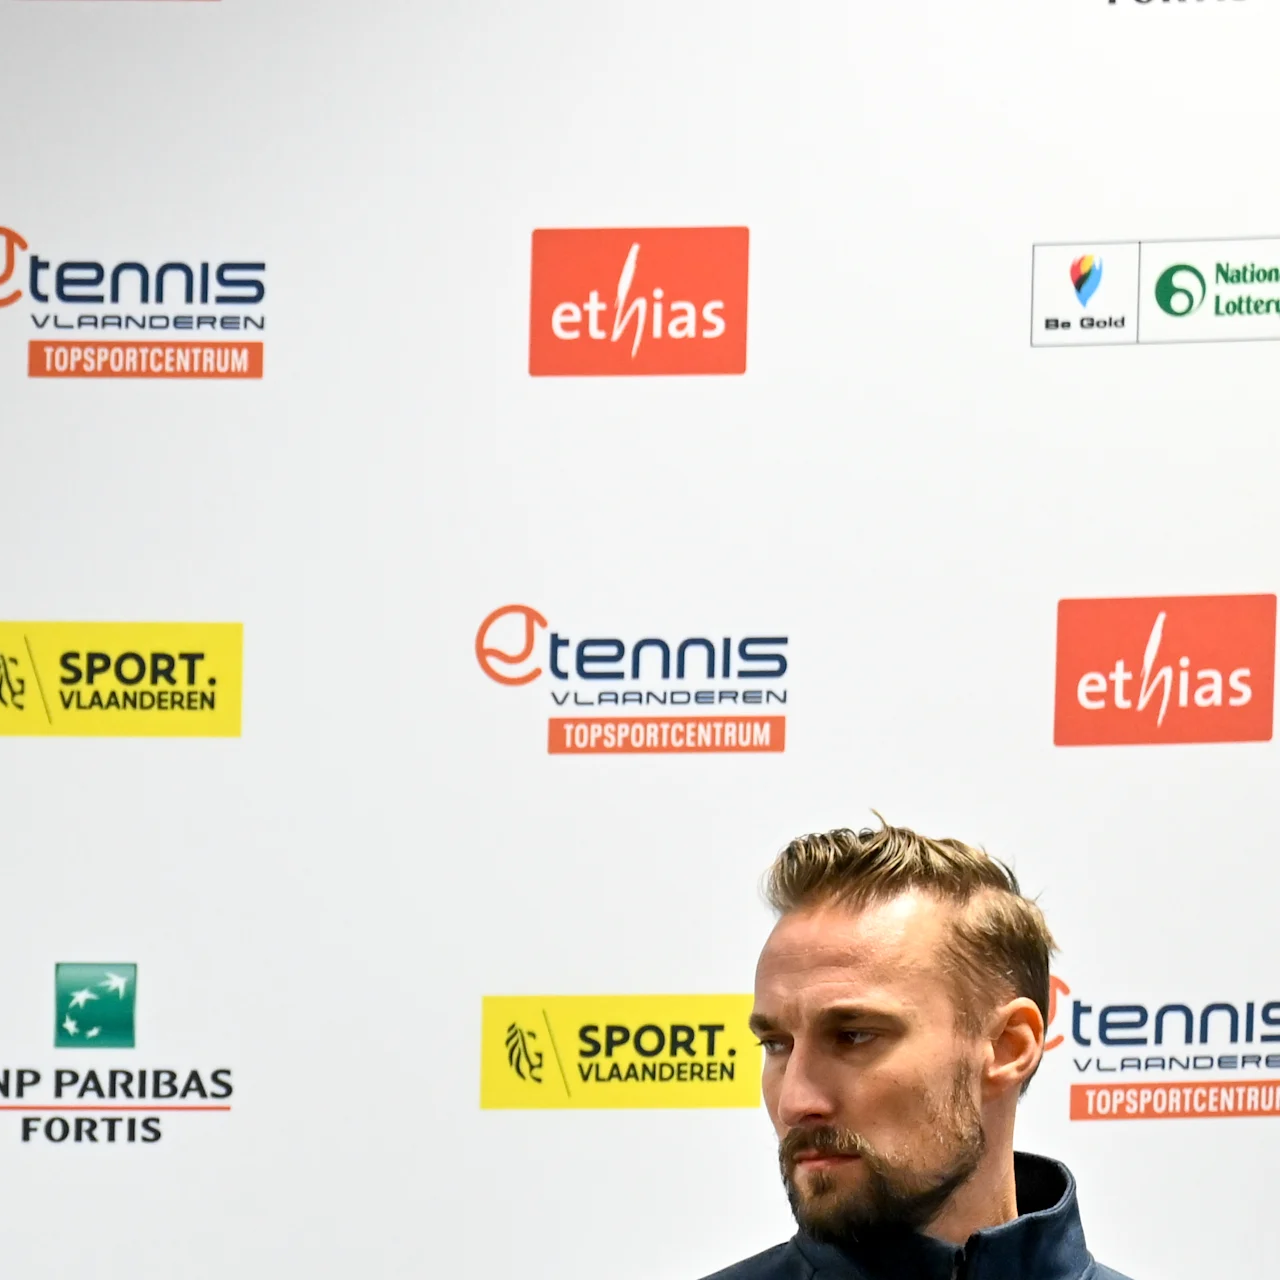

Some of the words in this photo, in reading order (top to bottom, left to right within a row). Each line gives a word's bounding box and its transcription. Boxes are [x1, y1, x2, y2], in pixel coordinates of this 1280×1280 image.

[29, 254, 266, 305] tennis
[1215, 262, 1280, 285] Nation
[551, 242, 726, 357] ethias
[30, 313, 265, 331] VLAANDEREN
[1044, 318, 1072, 330] Be
[1079, 316, 1125, 329] Gold
[44, 346, 249, 373] TOPSPORTCENTRUM
[59, 651, 217, 687] SPORT.
[549, 632, 789, 681] tennis
[1076, 611, 1253, 727] ethias
[59, 690, 216, 711] VLAANDEREN
[550, 689, 788, 707] VLAANDEREN
[563, 721, 771, 749] TOPSPORTCENTRUM
[578, 1023, 737, 1059] SPORT.
[577, 1061, 735, 1083] VLAANDEREN
[1073, 1053, 1280, 1073] VLAANDERE
[54, 1068, 234, 1099] PARIBAS
[1085, 1085, 1280, 1115] TOPSPORTCENTRU
[21, 1116, 162, 1143] FORTIS
